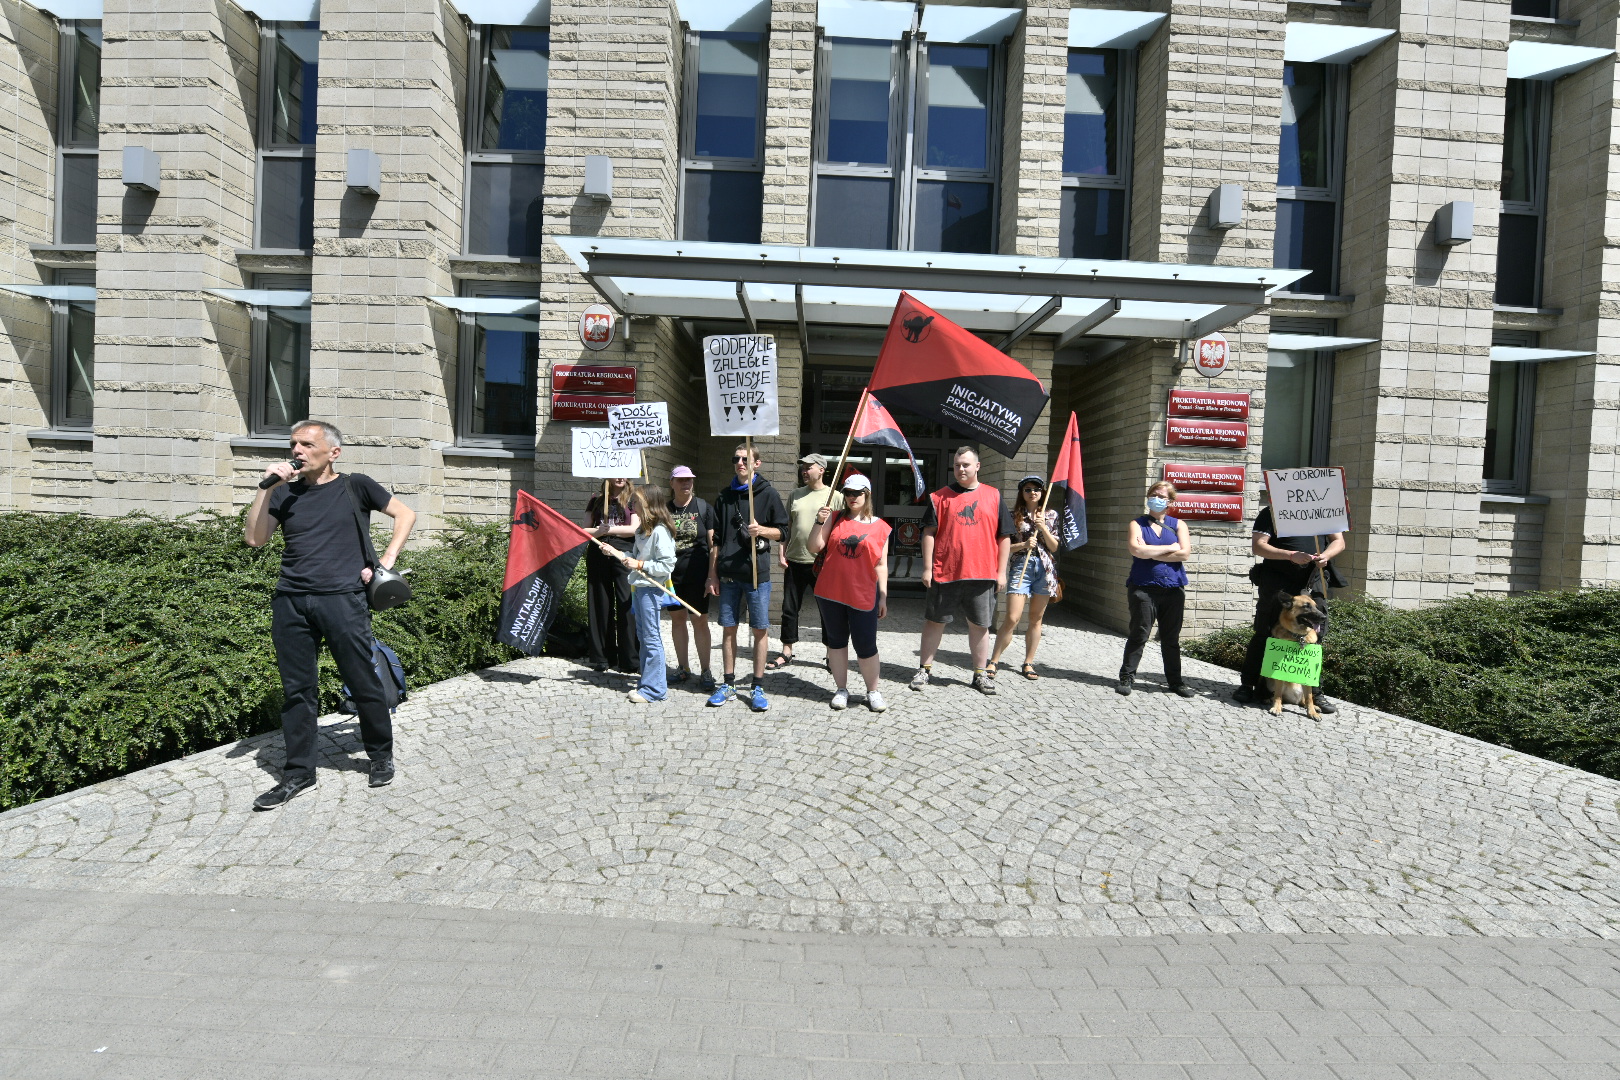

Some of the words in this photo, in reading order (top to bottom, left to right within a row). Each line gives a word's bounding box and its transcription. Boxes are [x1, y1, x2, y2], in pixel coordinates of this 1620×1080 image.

[713, 356, 770, 372] ZALEGŁE
[720, 390, 765, 404] TERAZ
[622, 405, 652, 416] DOŚĆ
[951, 384, 1022, 427] INICJATYWA
[946, 396, 1017, 436] PRACOWNICZA
[612, 419, 661, 431] WYZYSKU
[618, 428, 662, 438] ZAMÓWIEŃ
[970, 420, 988, 434] Związek
[988, 429, 1012, 445] Zawodowy
[616, 435, 670, 447] PUBLICZNYCH
[580, 451, 633, 468] WYZYSKU
[1275, 473, 1288, 481] W
[1292, 469, 1336, 480] OBRONIE
[1287, 488, 1330, 502] PRAW
[1279, 507, 1344, 520] PRACOWNICZYCH
